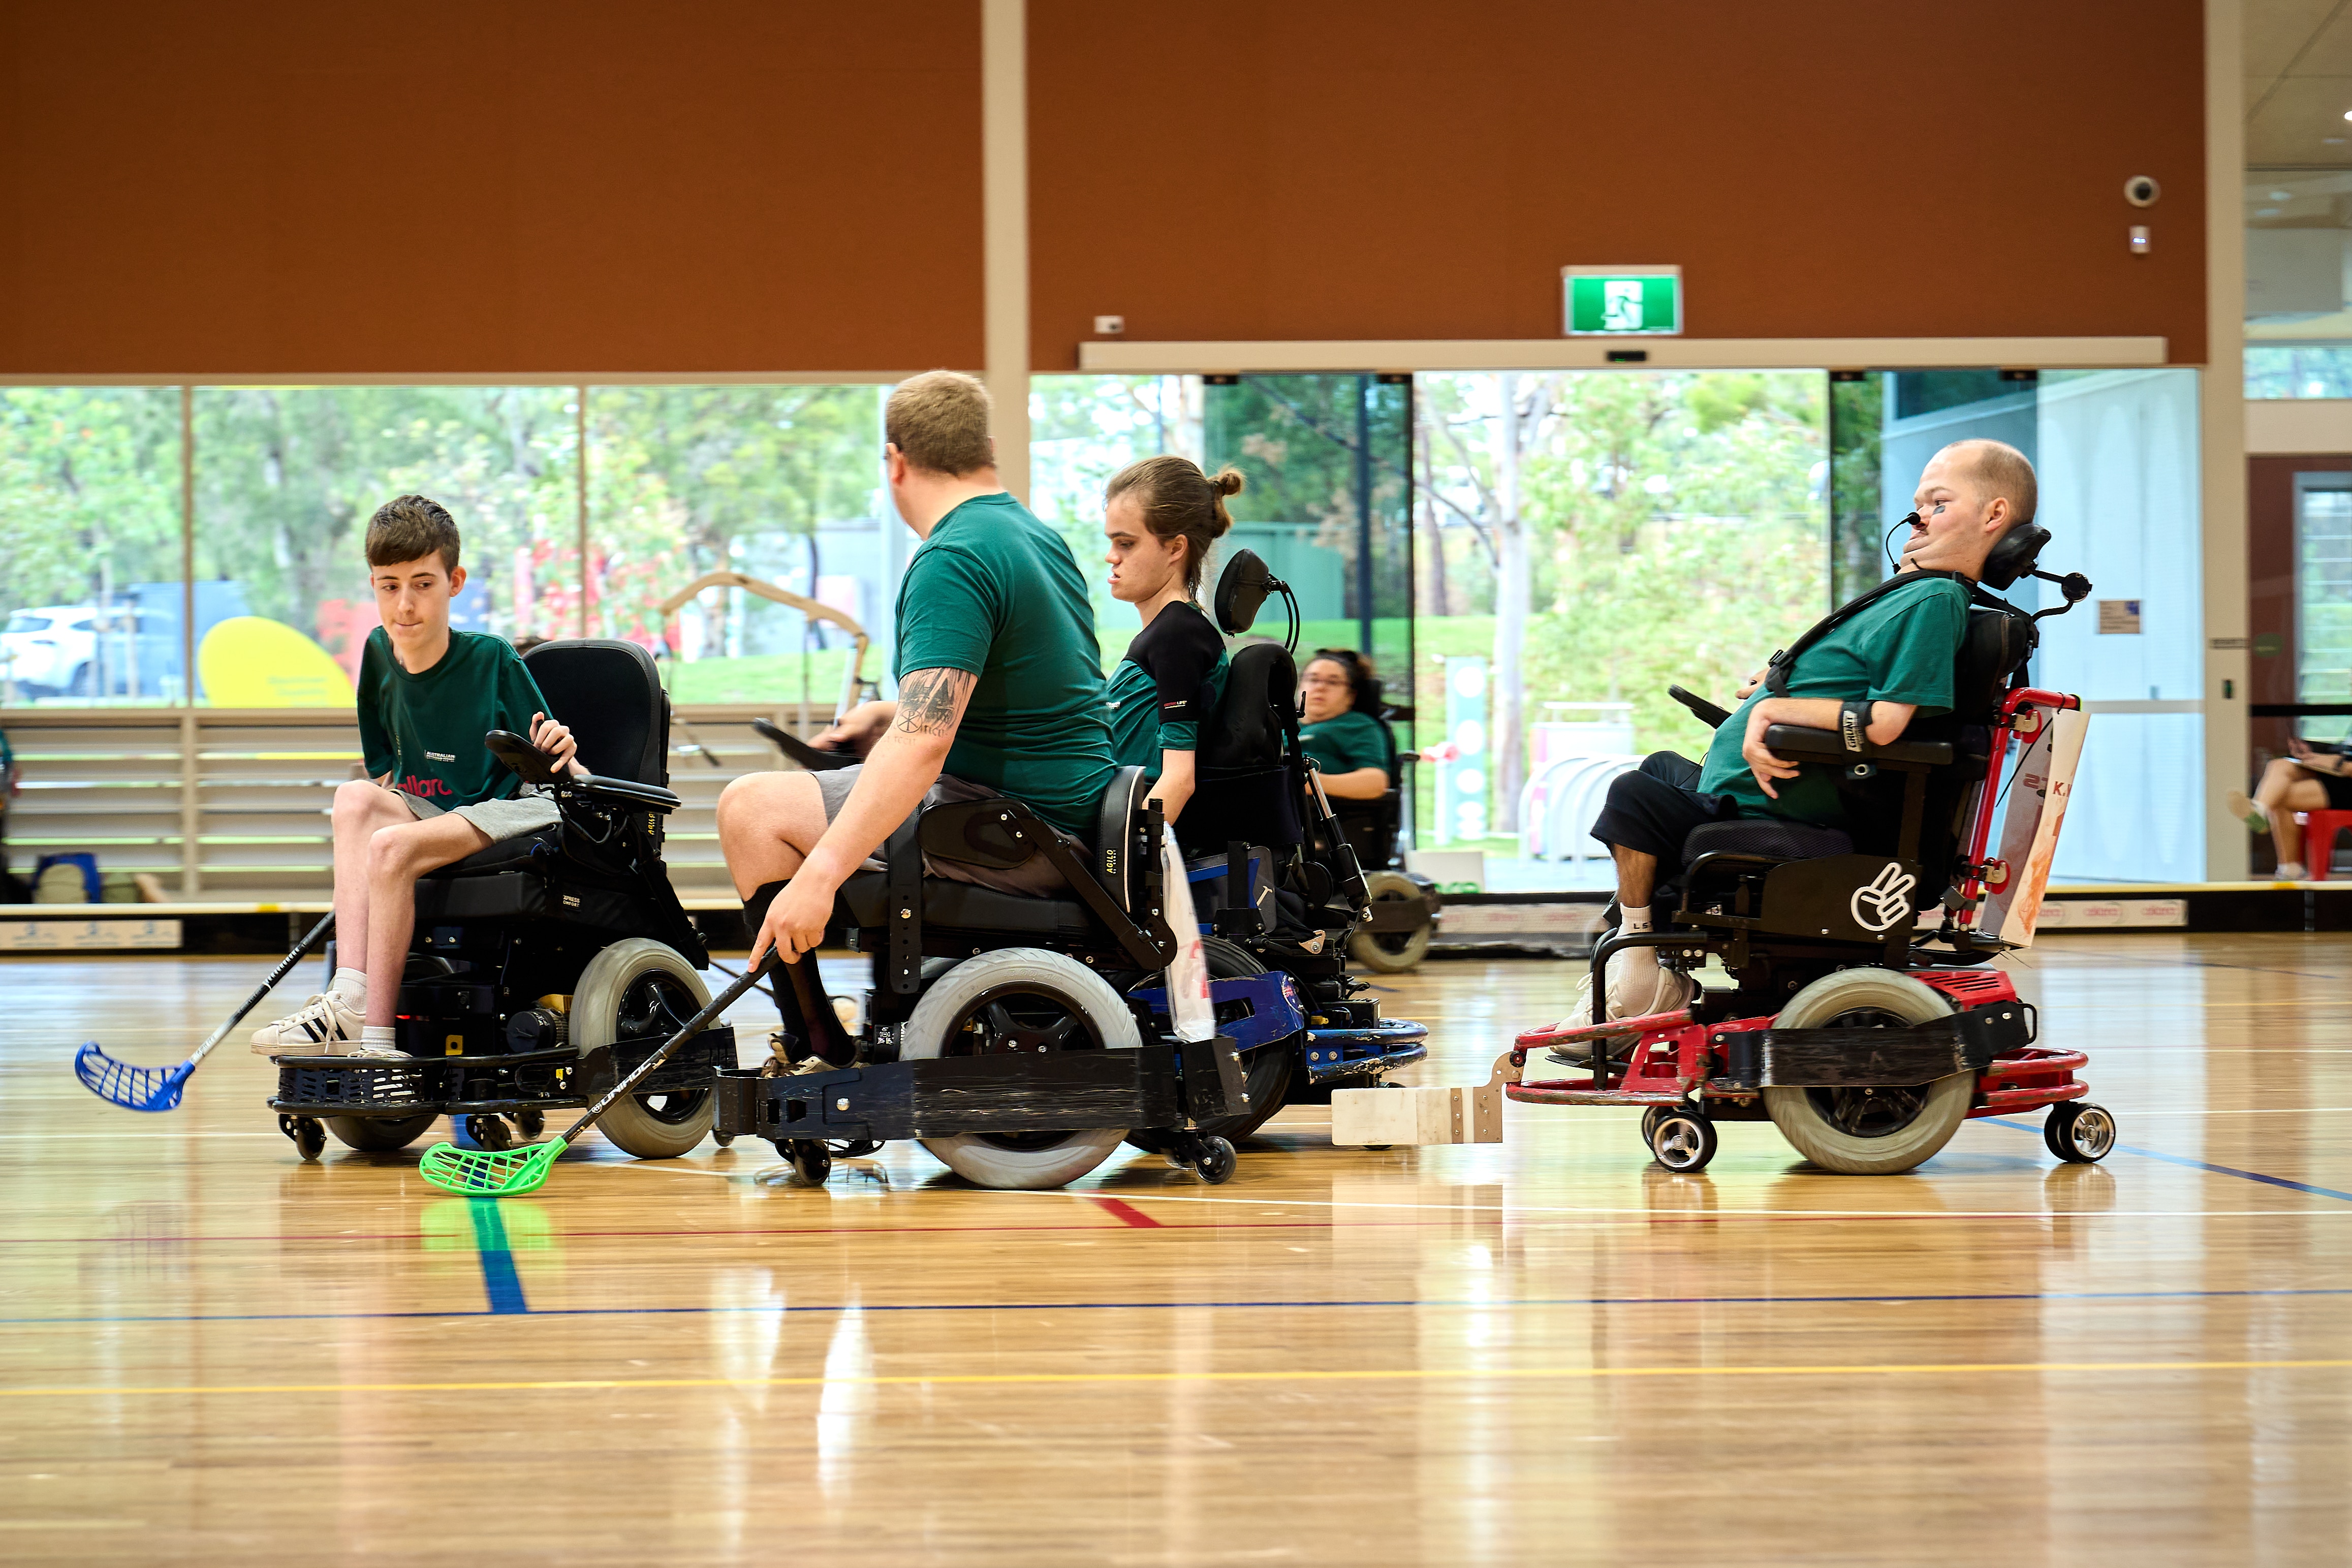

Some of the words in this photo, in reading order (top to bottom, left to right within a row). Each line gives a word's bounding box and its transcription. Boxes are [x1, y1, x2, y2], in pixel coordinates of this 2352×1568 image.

[1845, 716, 1857, 748] GRUNT
[1634, 921, 1652, 929] LS
[600, 1058, 652, 1106] UNIHOC
